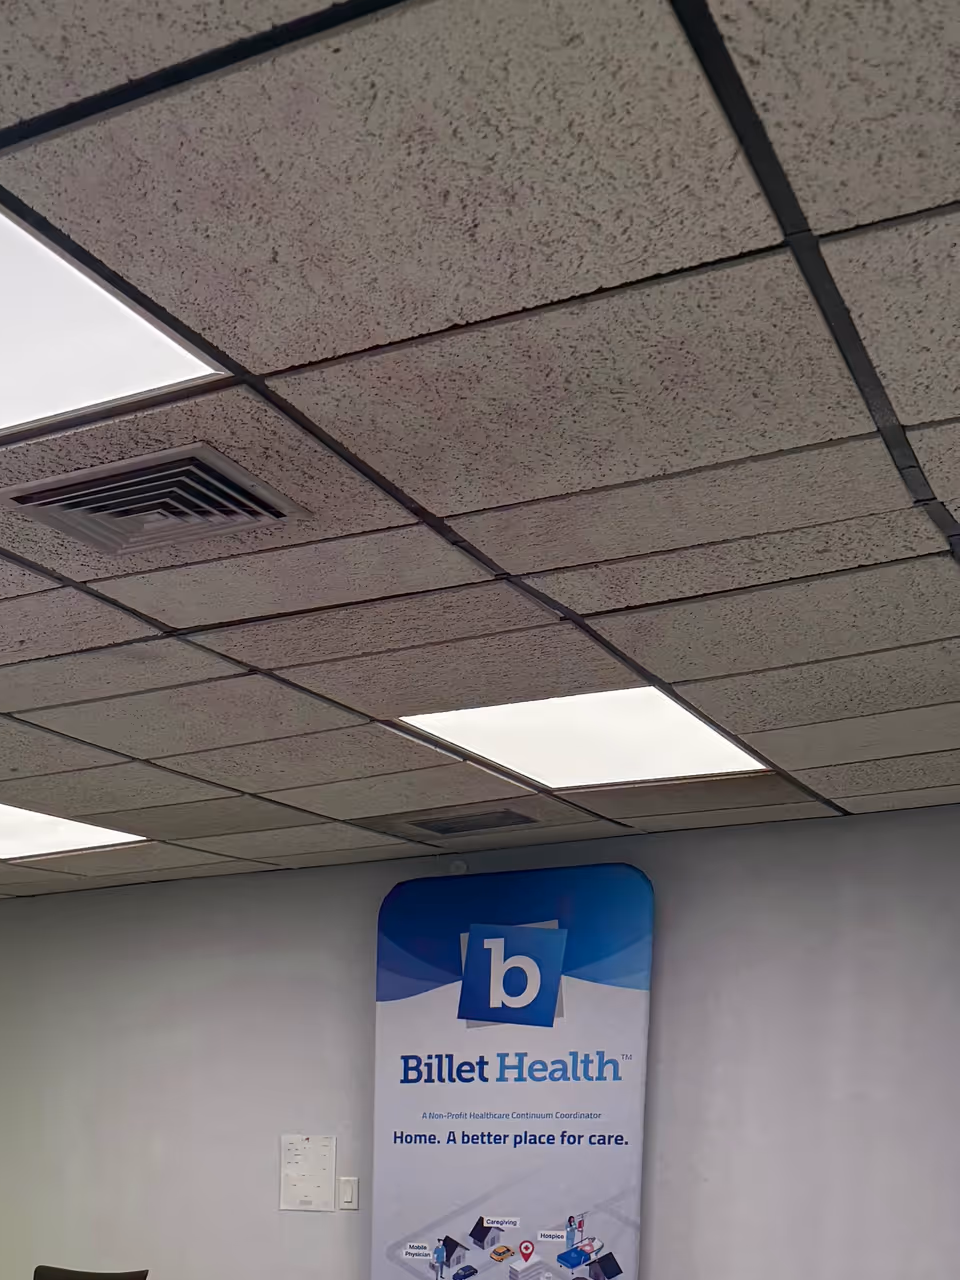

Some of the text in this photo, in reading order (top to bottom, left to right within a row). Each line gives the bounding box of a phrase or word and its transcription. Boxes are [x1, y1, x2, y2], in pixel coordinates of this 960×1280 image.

[483, 938, 541, 1008] b
[400, 1054, 489, 1084] Billet
[496, 1051, 622, 1082] Health
[428, 1111, 468, 1120] Non-Profit
[469, 1111, 510, 1120] Healthcare
[511, 1111, 553, 1120] Continuum
[555, 1111, 602, 1120] Coordinator
[393, 1130, 629, 1149] Home. A better place for care.
[486, 1218, 517, 1226] Caregiving
[540, 1232, 565, 1240] Hospice
[405, 1251, 431, 1259] Physician
